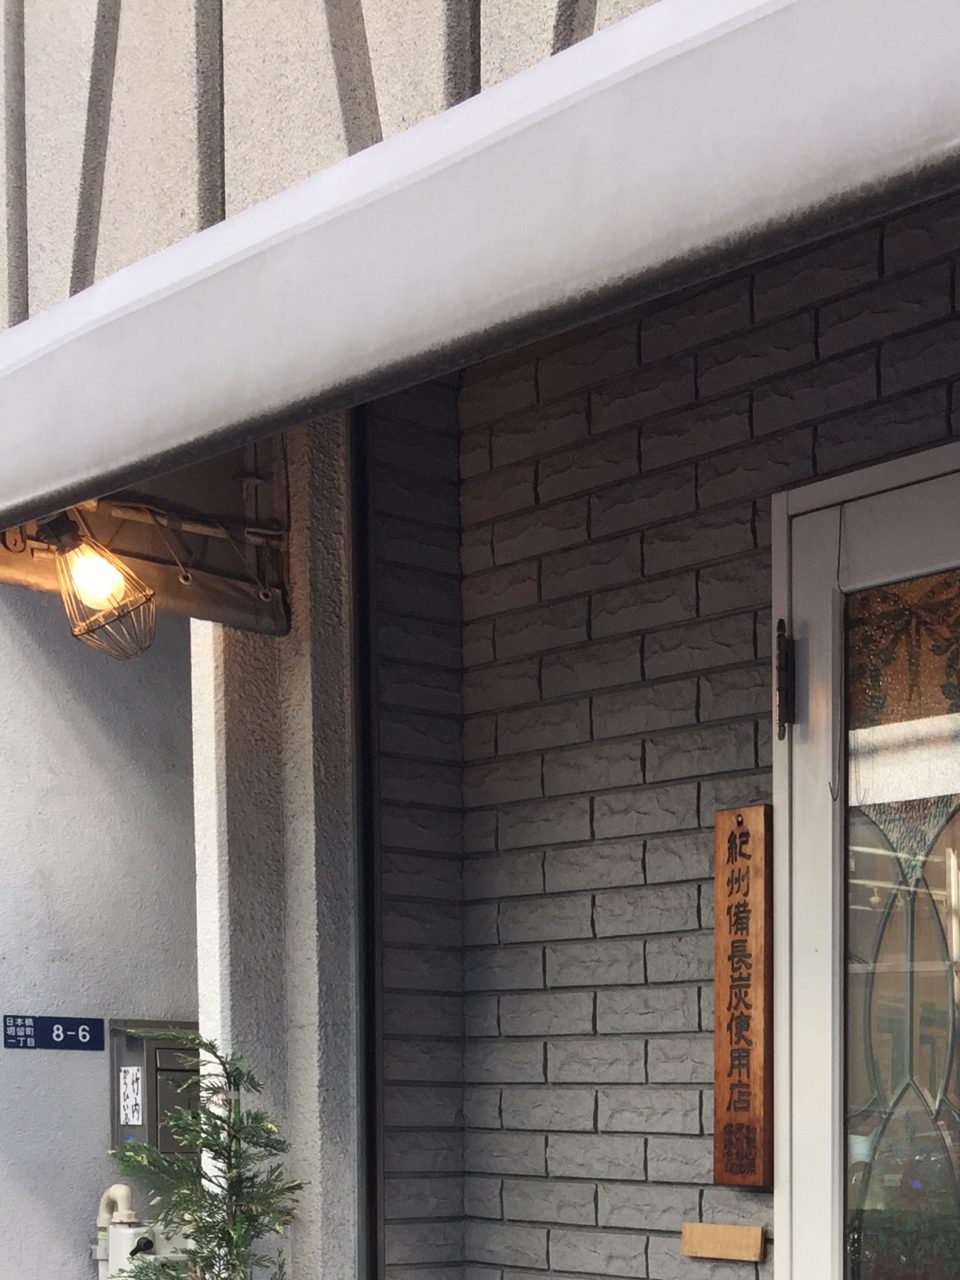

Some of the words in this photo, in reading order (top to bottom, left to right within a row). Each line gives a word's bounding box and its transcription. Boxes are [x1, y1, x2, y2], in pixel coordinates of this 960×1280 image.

[725, 830, 752, 1113] 紀州備長炭使用店
[6, 1017, 34, 1026] 日本橋
[6, 1027, 35, 1036] 堀留町
[52, 1024, 91, 1043] 8-6
[7, 1037, 35, 1047] 一丁目
